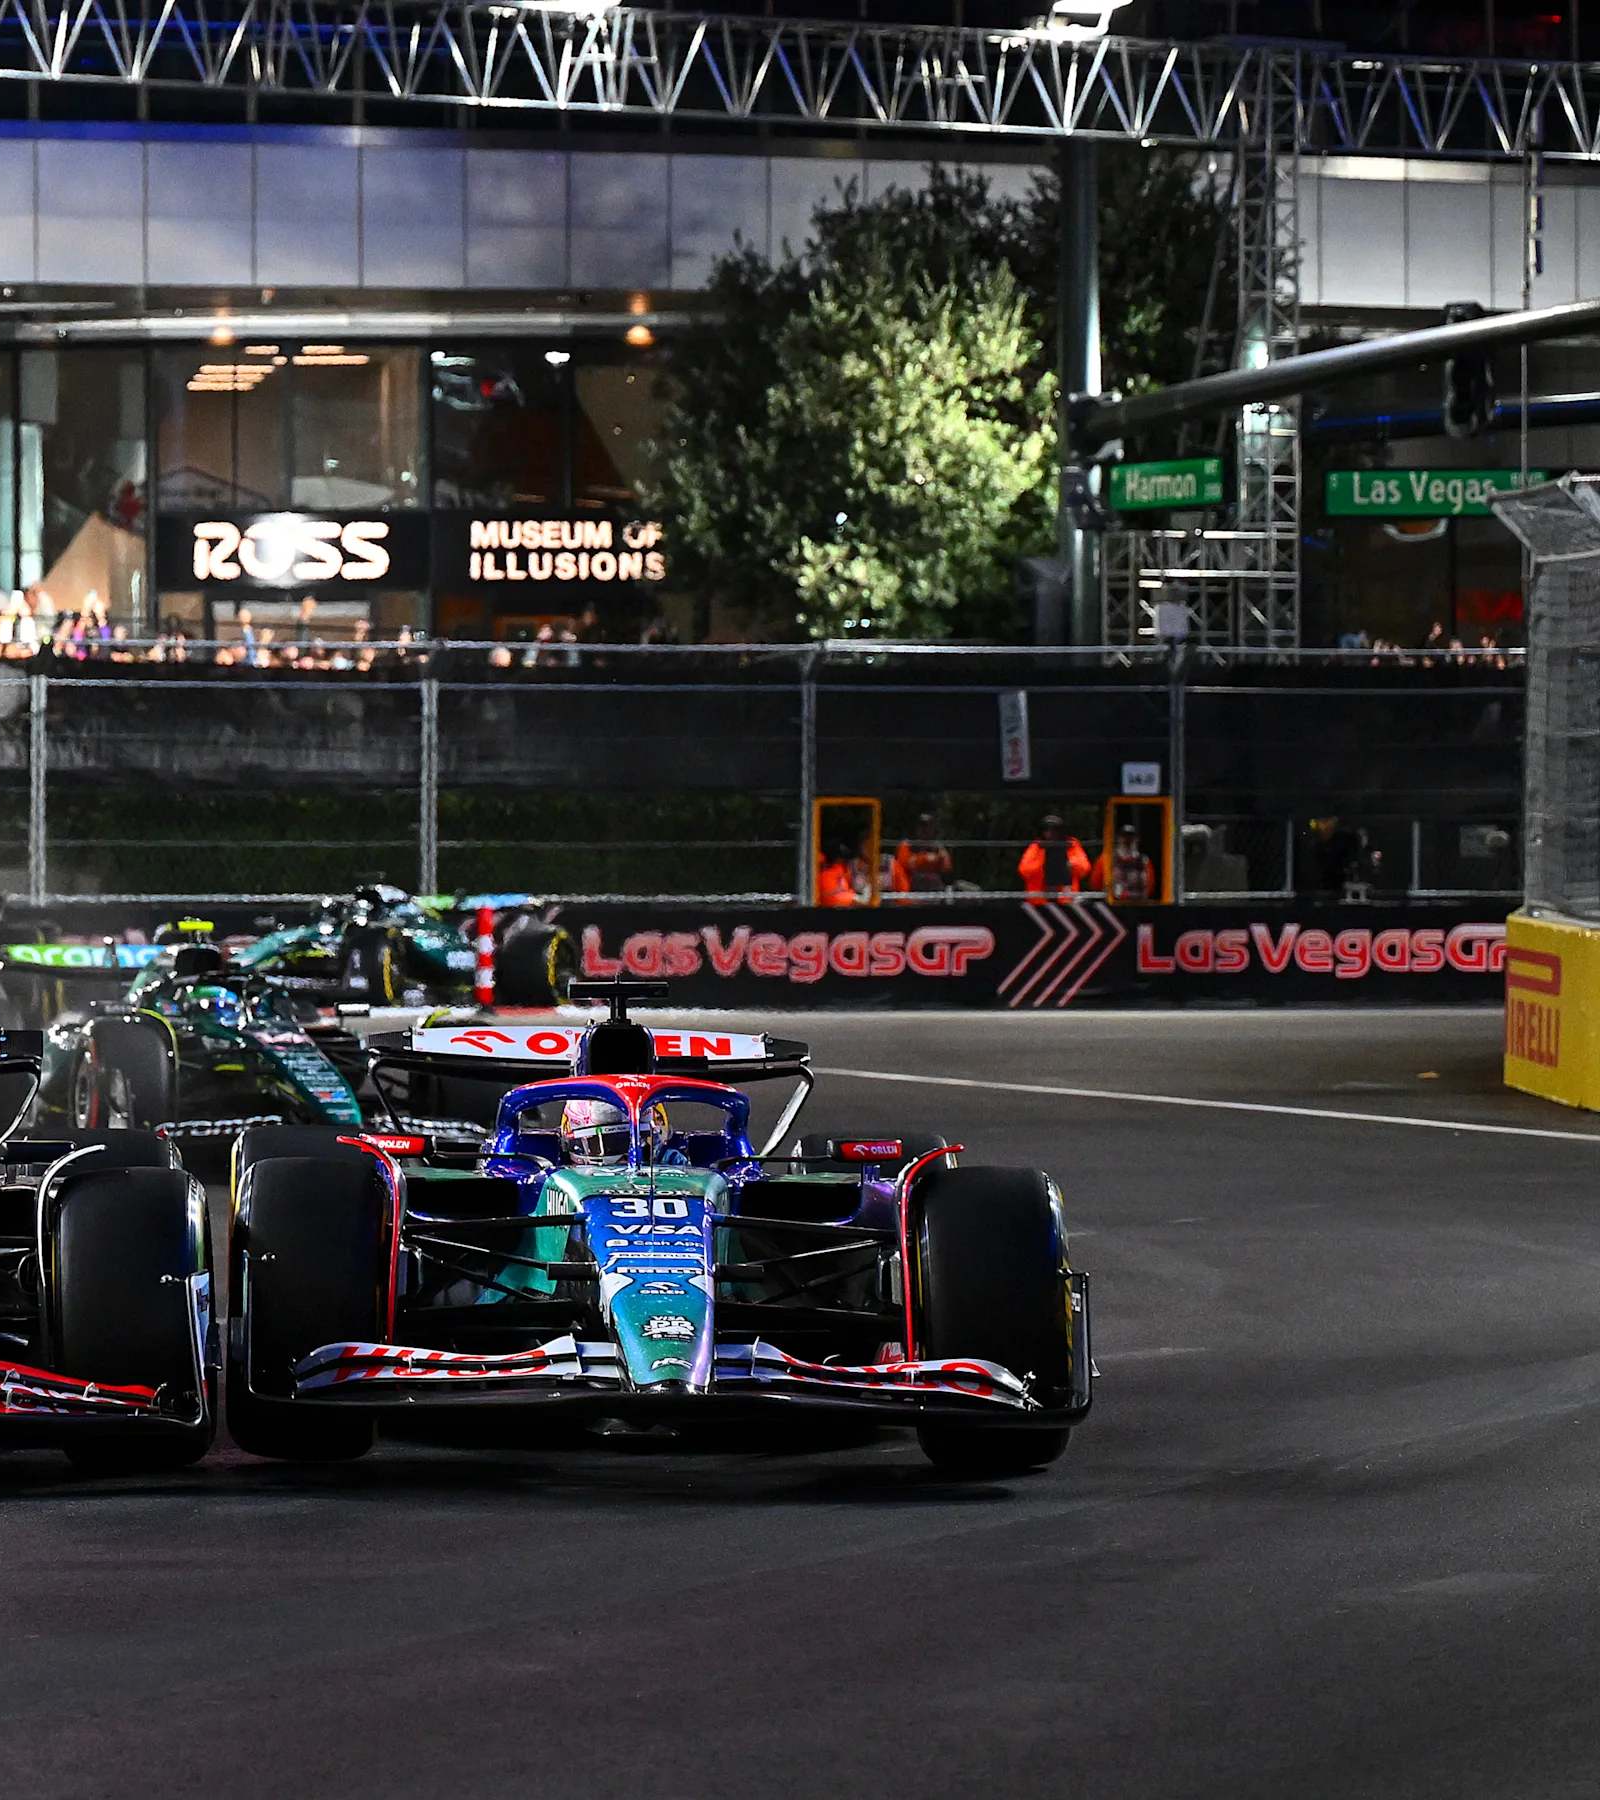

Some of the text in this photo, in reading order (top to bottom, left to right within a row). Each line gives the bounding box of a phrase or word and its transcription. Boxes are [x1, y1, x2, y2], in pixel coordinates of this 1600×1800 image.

[1125, 468, 1197, 503] Harmon
[1353, 471, 1401, 505] Las
[1408, 471, 1495, 515] Vegas
[469, 520, 663, 549] MUSEUM OF
[193, 521, 390, 580] ROSS
[469, 551, 666, 582] ILLUSIONS
[526, 1031, 732, 1056] OEN
[615, 1081, 651, 1089] ORLEN
[871, 1145, 898, 1154] ORLEN
[610, 1197, 690, 1218] 30
[605, 1224, 703, 1236] VISA
[616, 1266, 704, 1275] PIRELLI
[333, 1346, 549, 1383] HUGO
